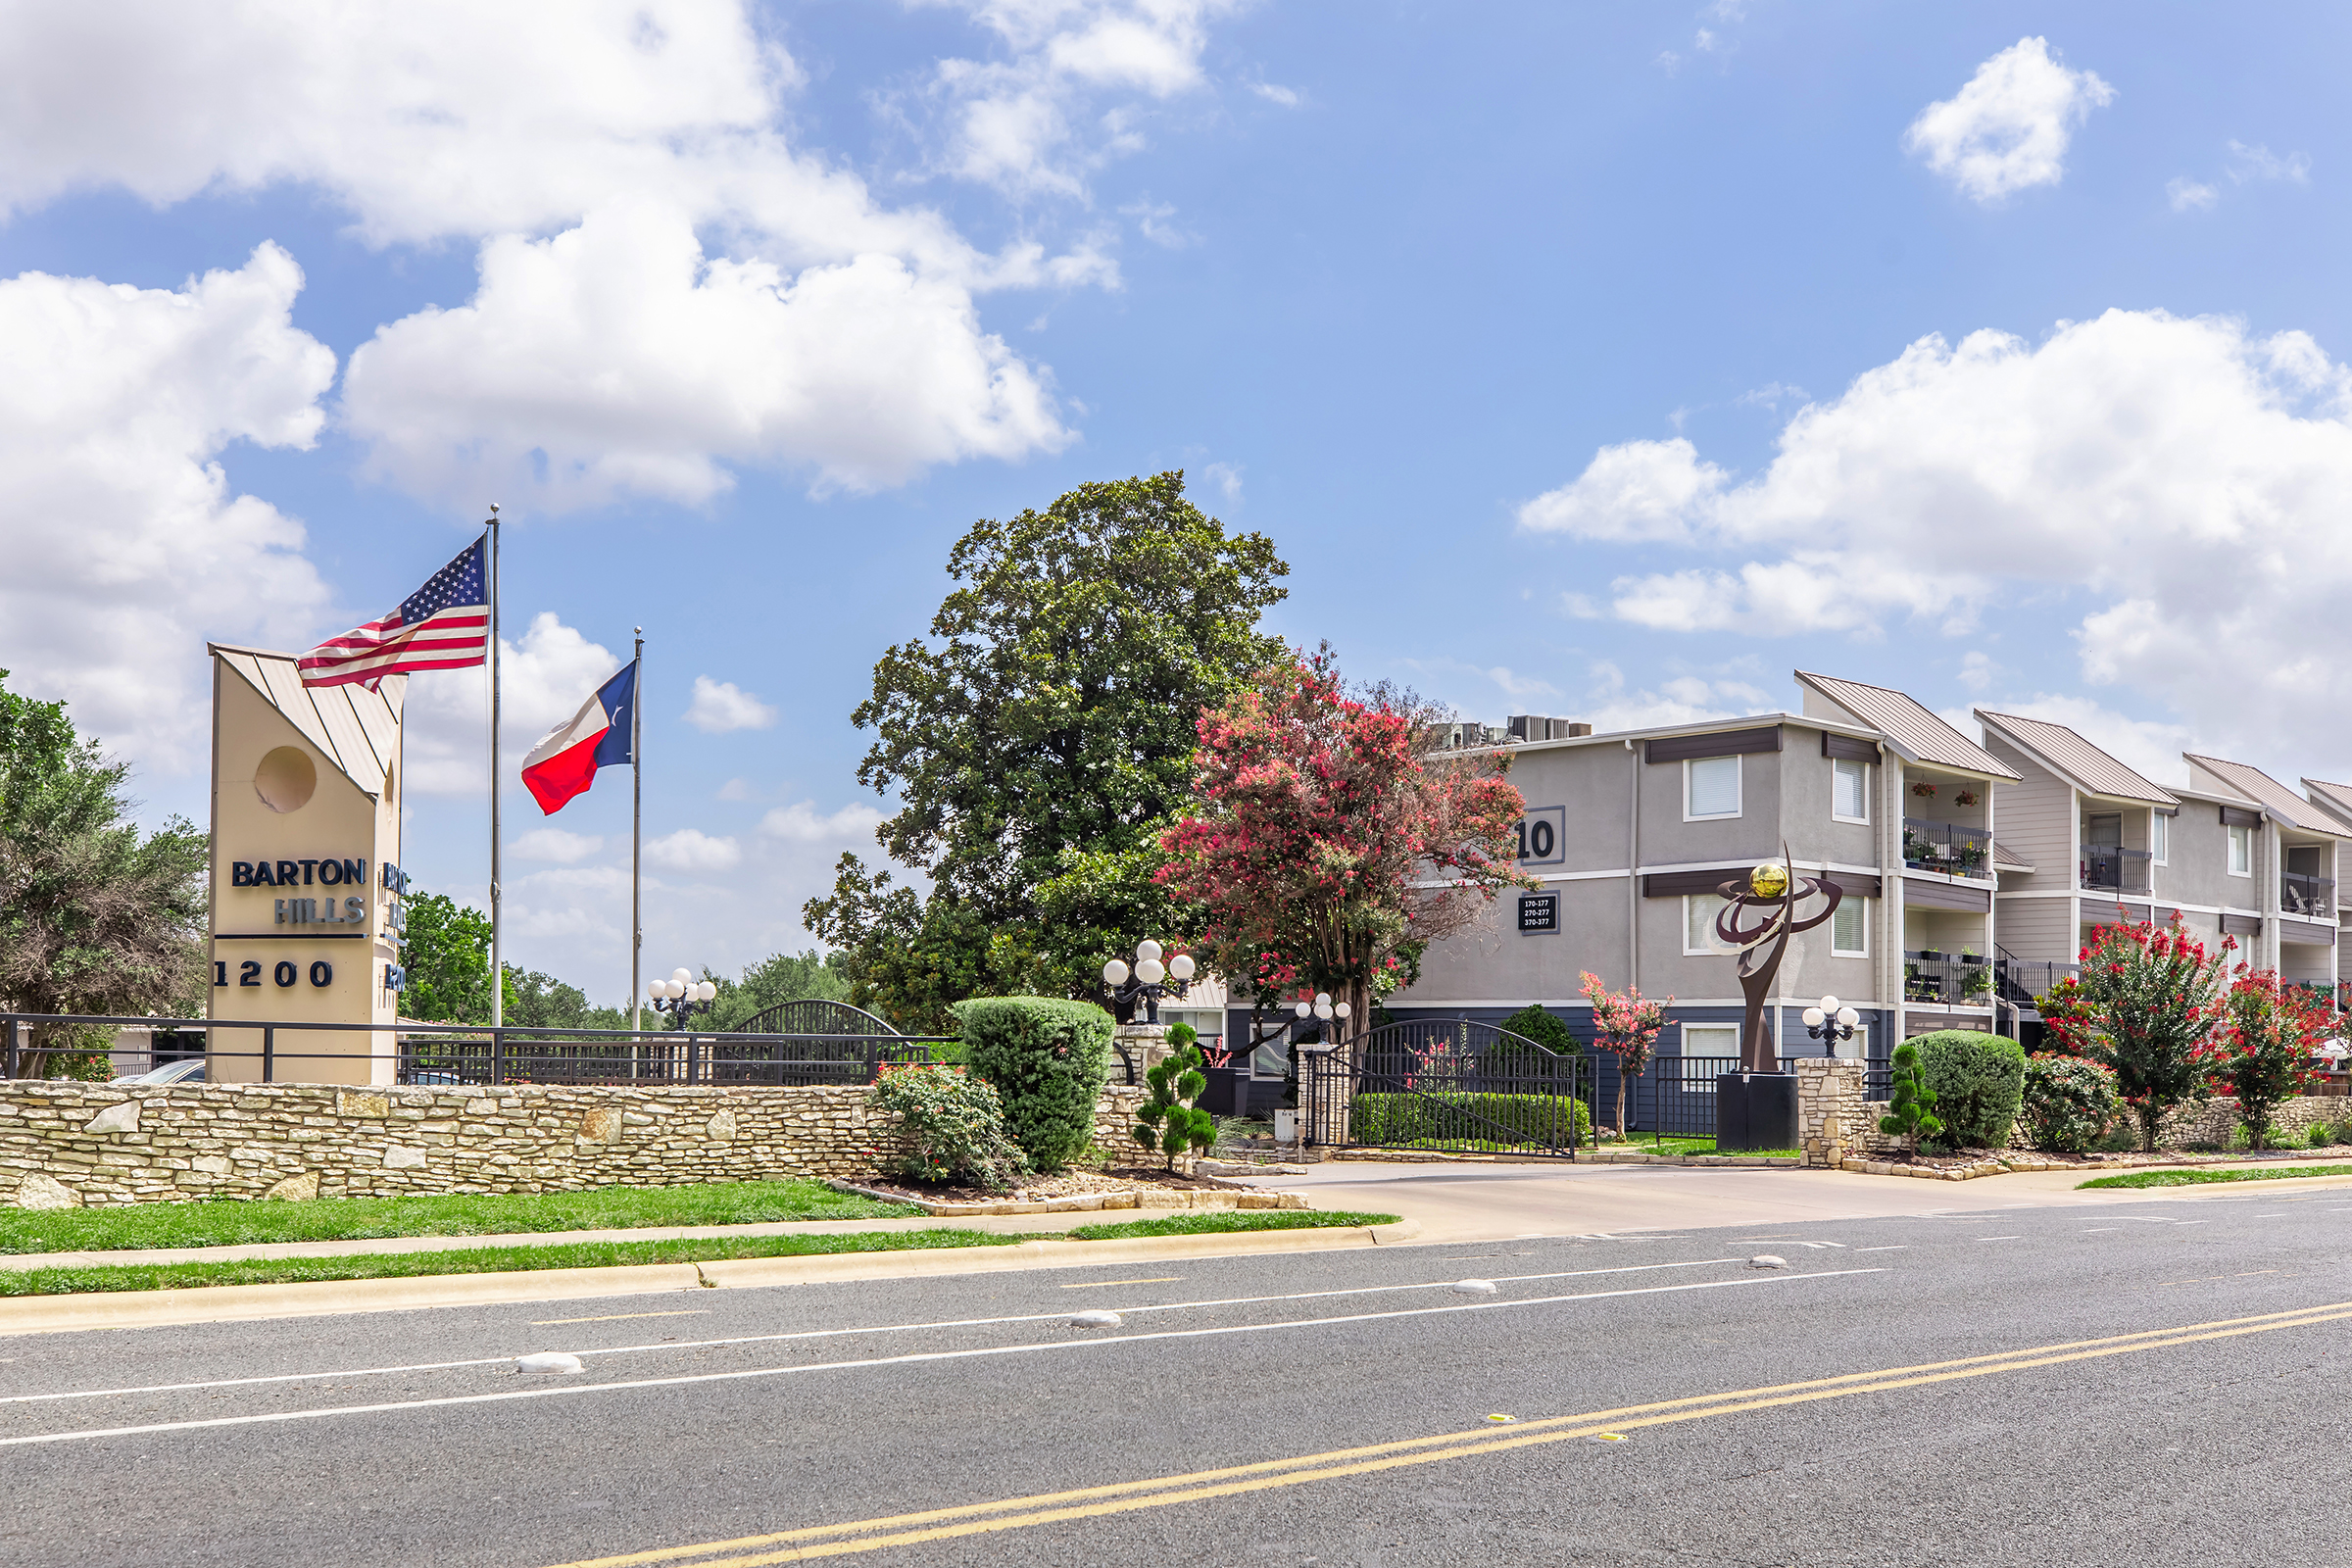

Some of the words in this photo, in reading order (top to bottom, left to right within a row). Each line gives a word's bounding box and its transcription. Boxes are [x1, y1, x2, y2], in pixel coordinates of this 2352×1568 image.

[1514, 820, 1553, 858] 10
[232, 858, 366, 886] BARTON
[274, 897, 366, 924] HILLS
[214, 960, 332, 988] 1200
